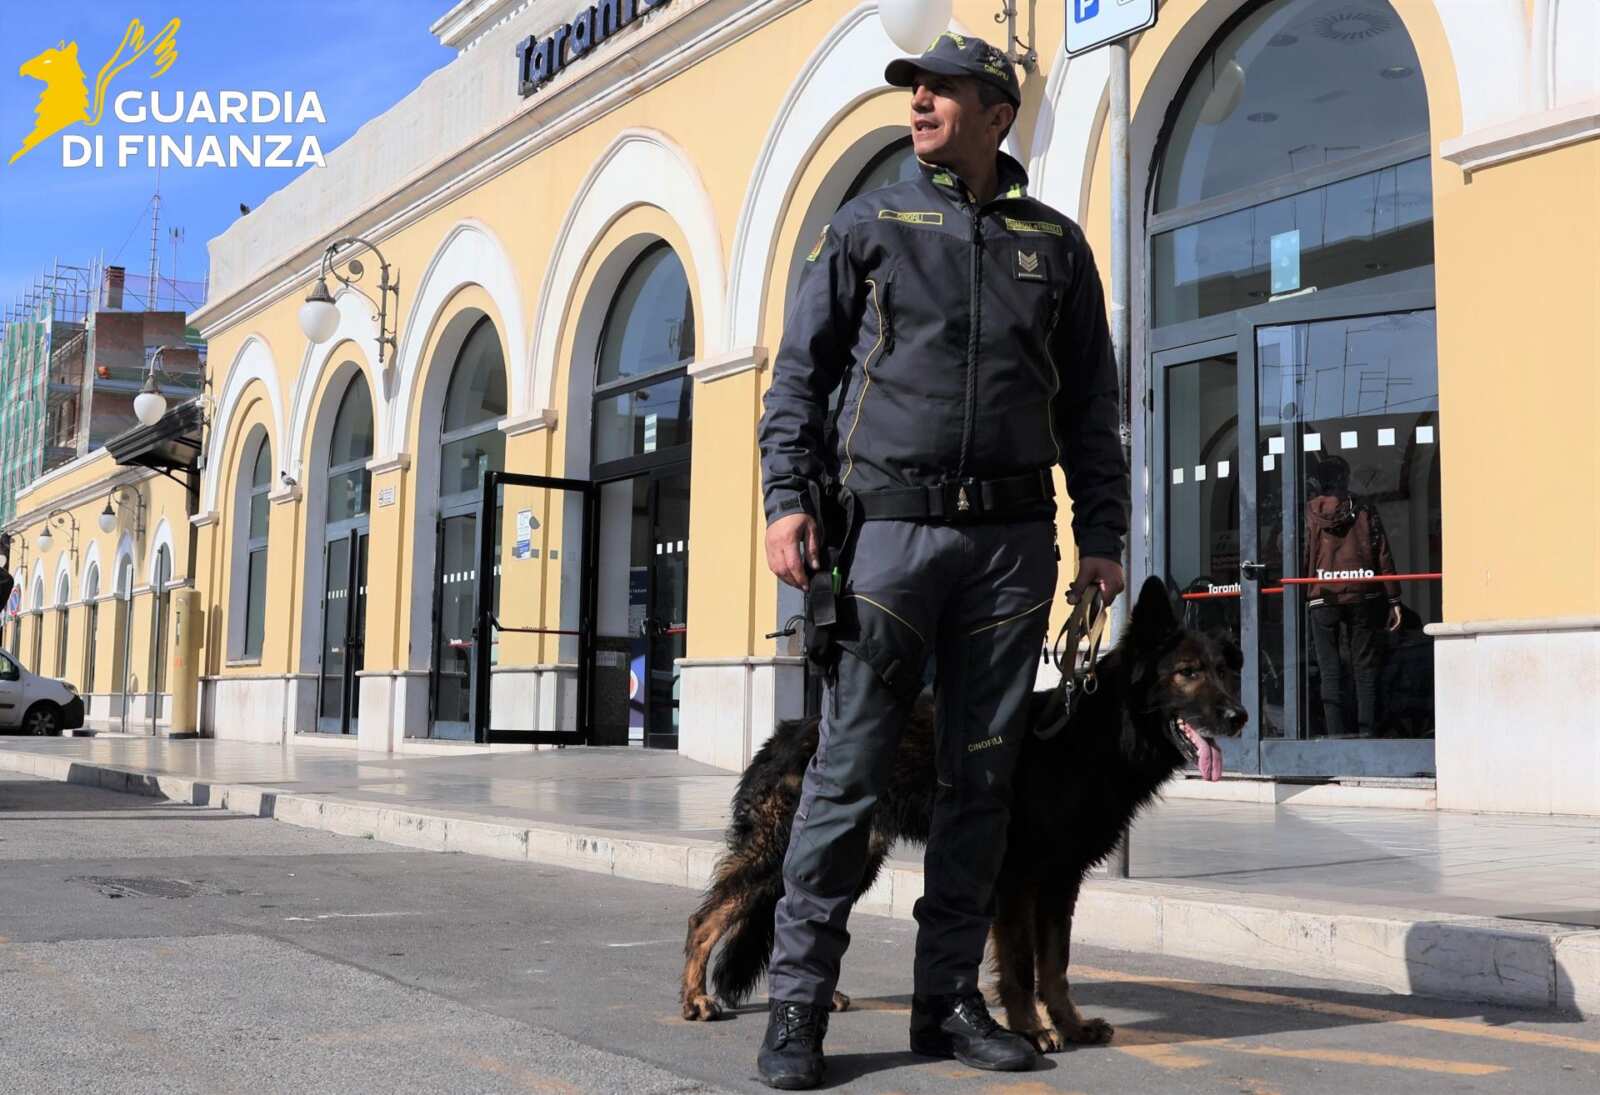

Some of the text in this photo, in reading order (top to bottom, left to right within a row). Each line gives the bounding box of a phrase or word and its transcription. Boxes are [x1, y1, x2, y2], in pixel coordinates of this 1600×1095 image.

[516, 0, 660, 97] Taran
[1316, 568, 1375, 580] Taranto
[1207, 582, 1241, 594] Tarant
